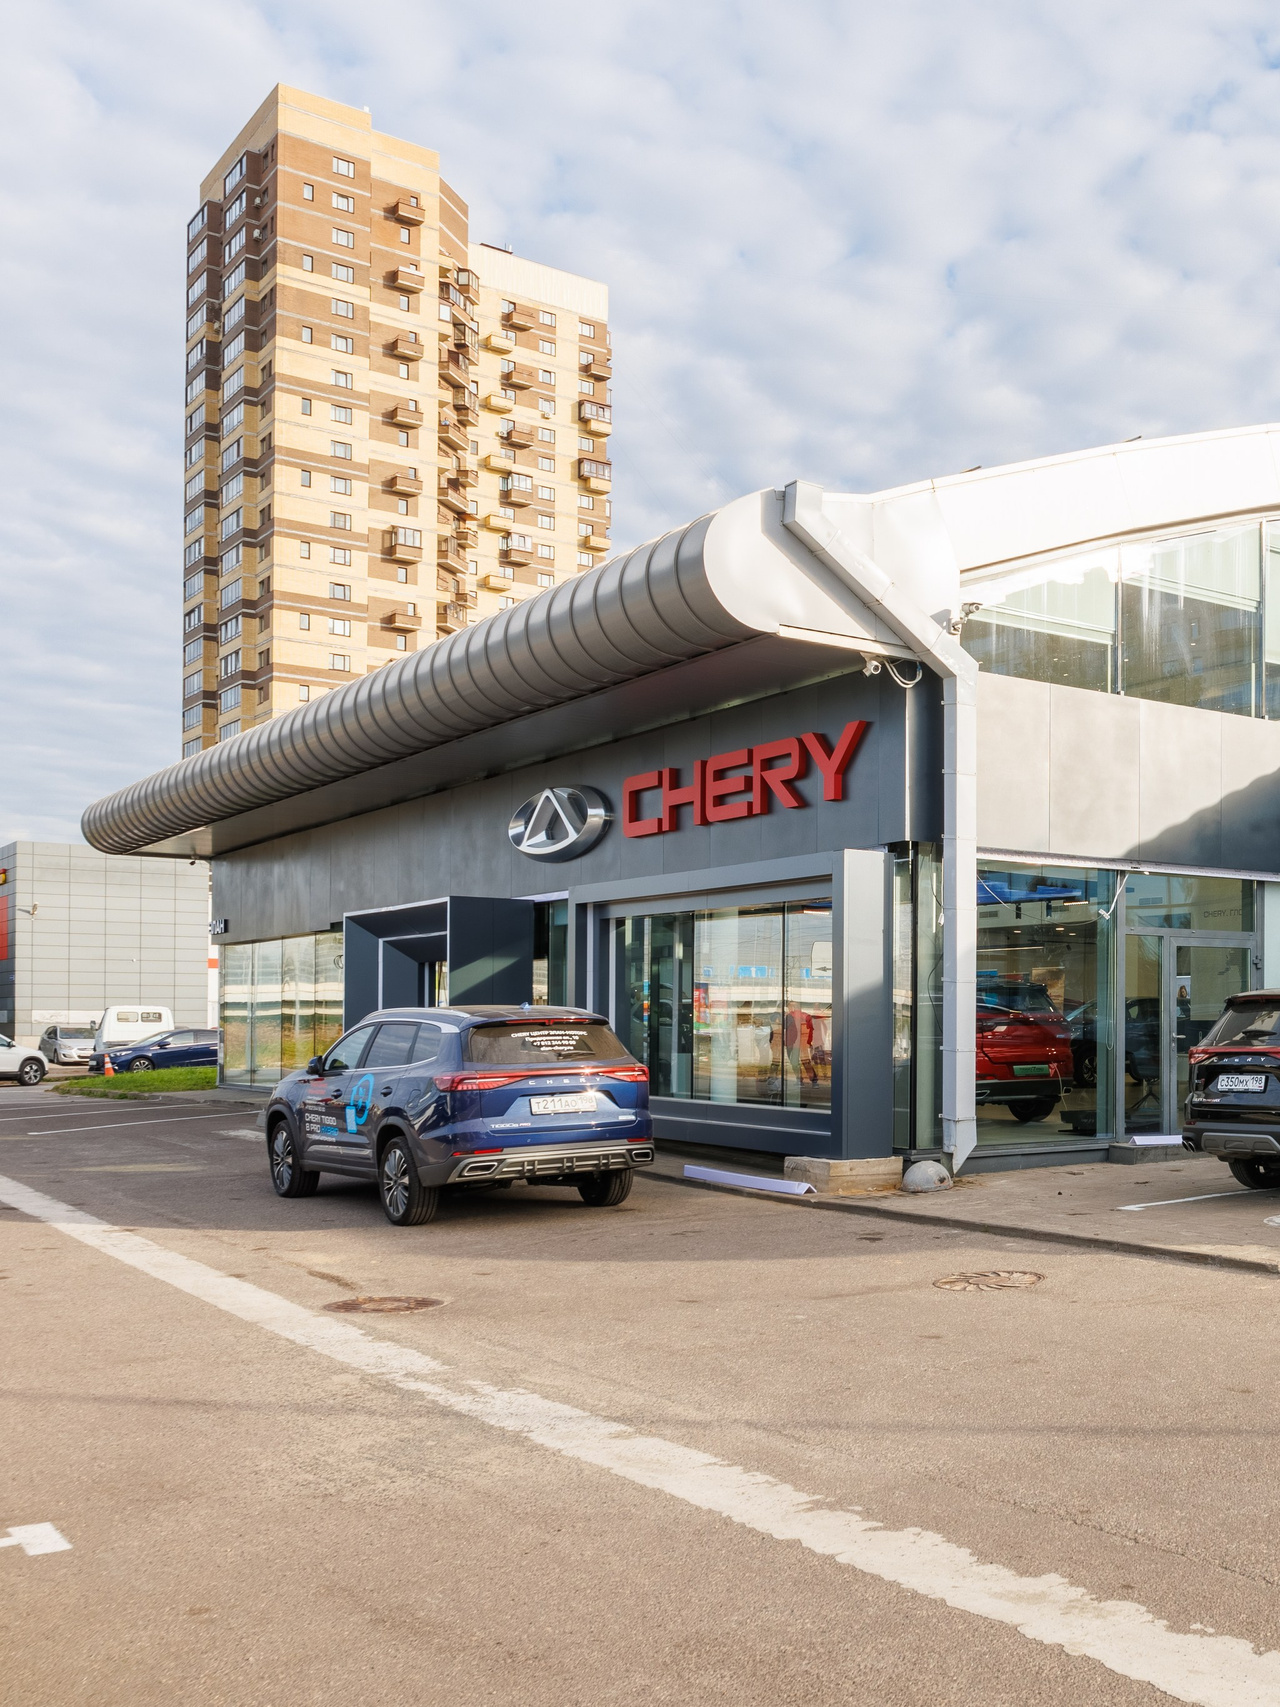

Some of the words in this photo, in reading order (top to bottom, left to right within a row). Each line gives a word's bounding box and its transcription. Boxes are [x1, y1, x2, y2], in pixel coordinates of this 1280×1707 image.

[622, 719, 868, 838] CHERY
[528, 1077, 601, 1085] CHERY
[1251, 1076, 1263, 1085] 198
[305, 1113, 321, 1123] CHERY
[310, 1124, 320, 1133] PRO
